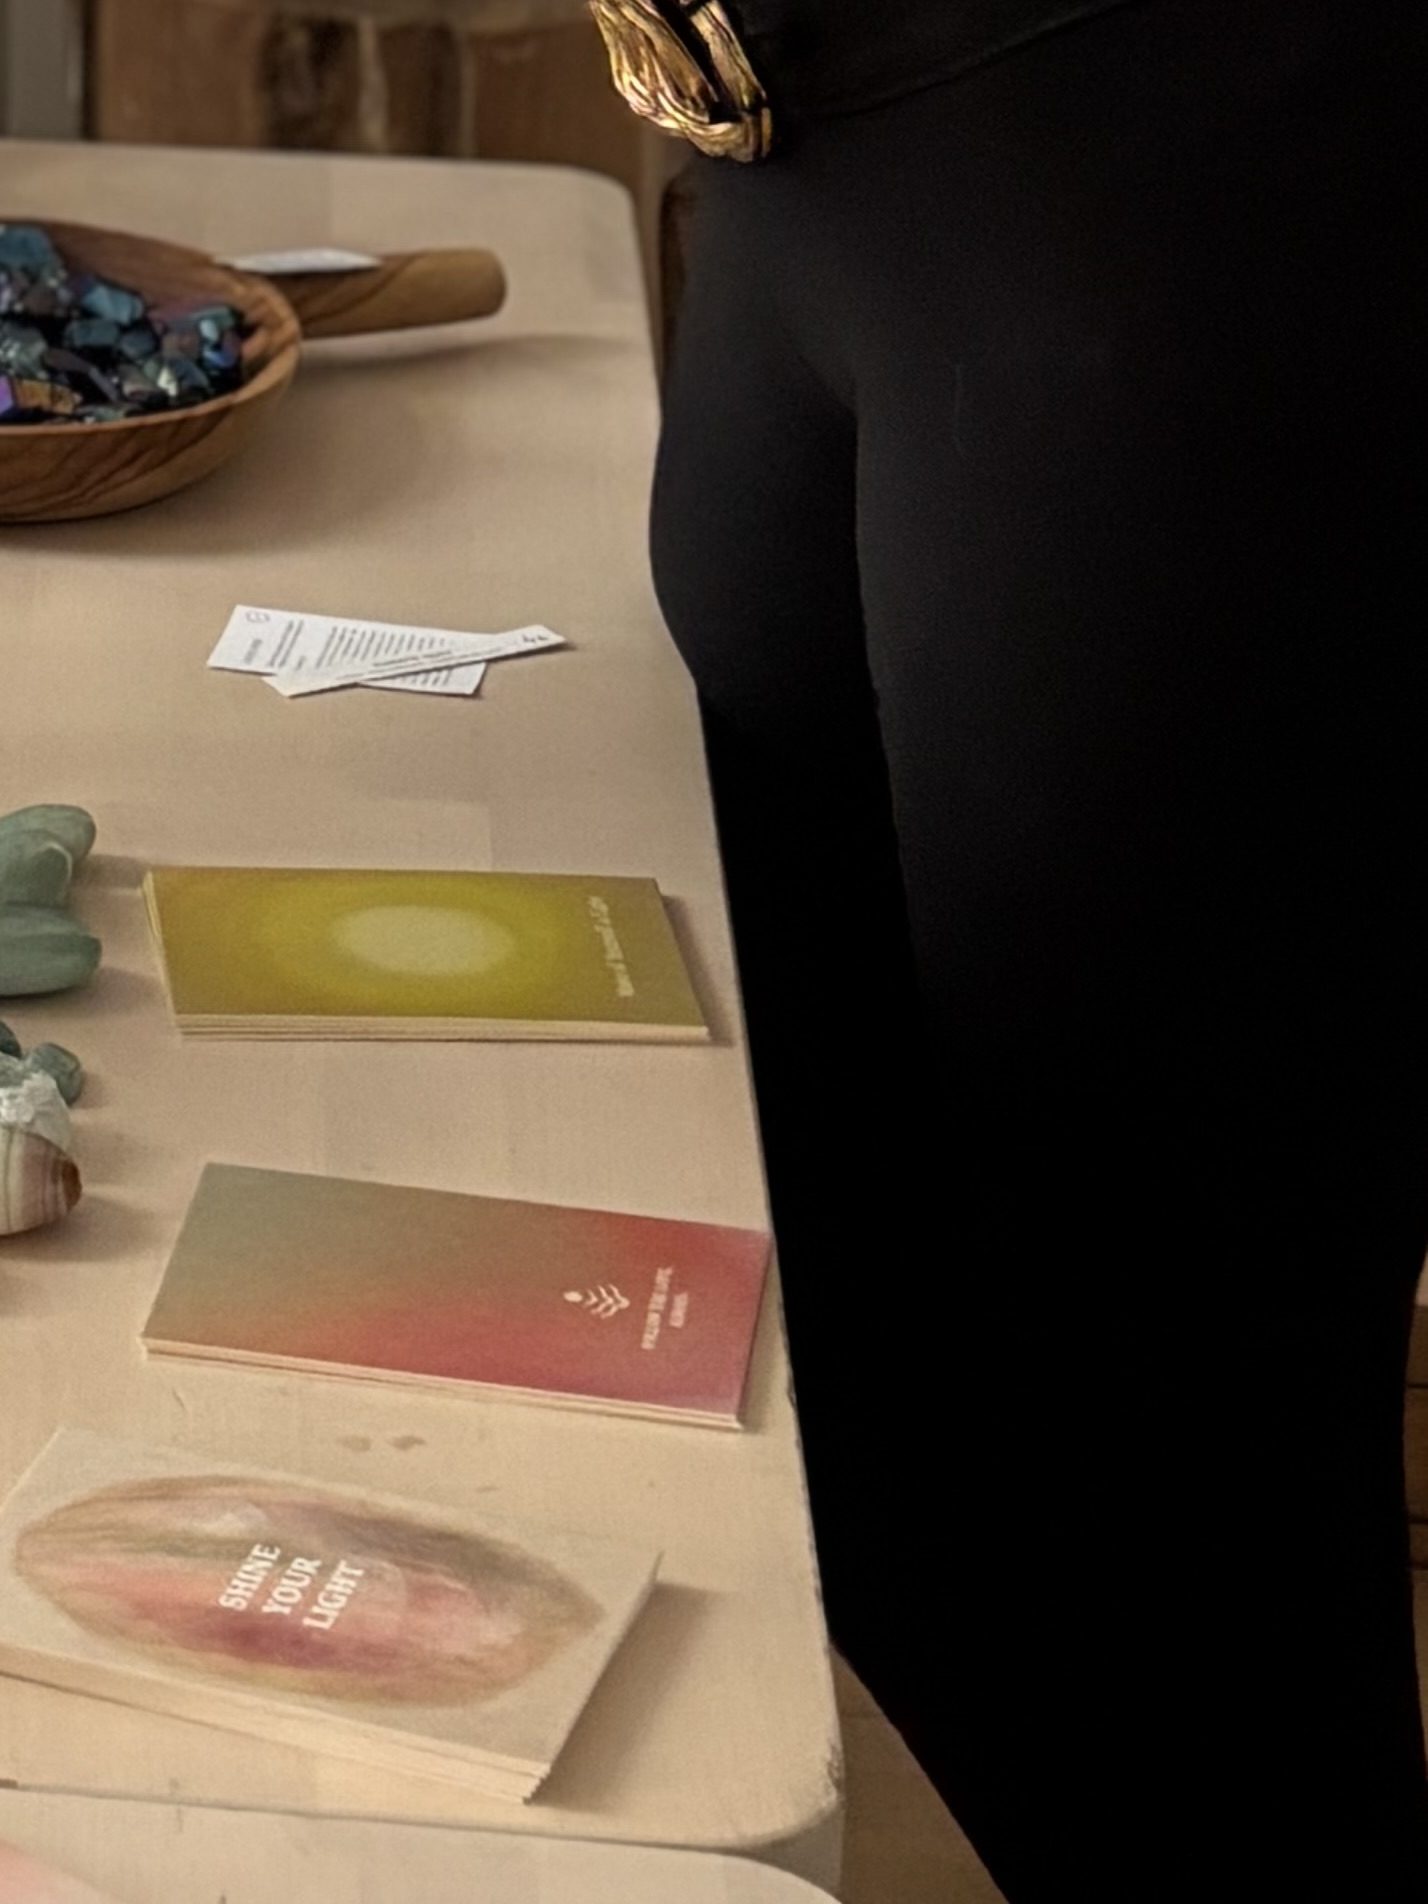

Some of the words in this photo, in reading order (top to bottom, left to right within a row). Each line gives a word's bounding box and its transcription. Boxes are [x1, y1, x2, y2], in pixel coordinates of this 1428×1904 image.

[218, 1543, 281, 1611] SHINE
[261, 1557, 322, 1615] YOUR
[302, 1559, 365, 1630] LIGHT
